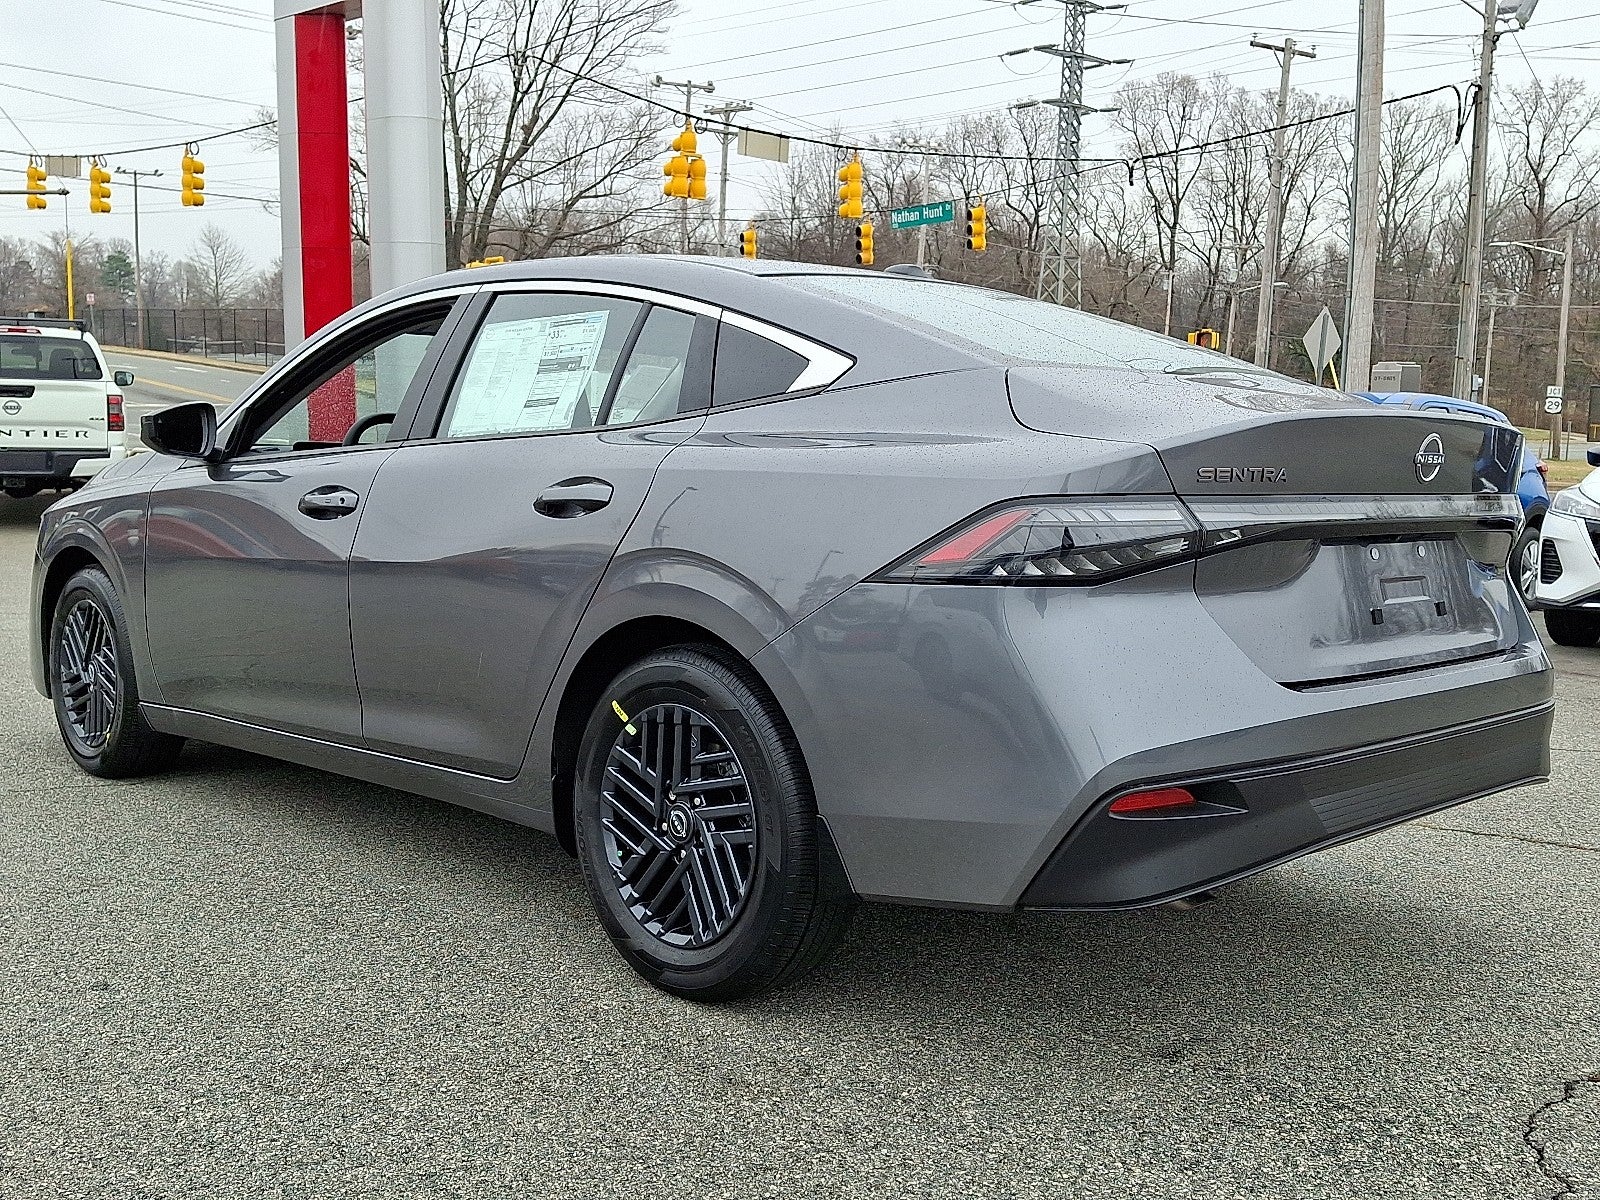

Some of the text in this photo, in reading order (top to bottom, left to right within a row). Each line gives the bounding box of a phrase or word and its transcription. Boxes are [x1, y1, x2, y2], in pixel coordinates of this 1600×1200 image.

[892, 211, 920, 223] Nathan
[923, 205, 943, 219] Hunt
[1548, 387, 1561, 396] JCT
[1547, 400, 1561, 410] 29
[1197, 467, 1287, 483] SENTRA
